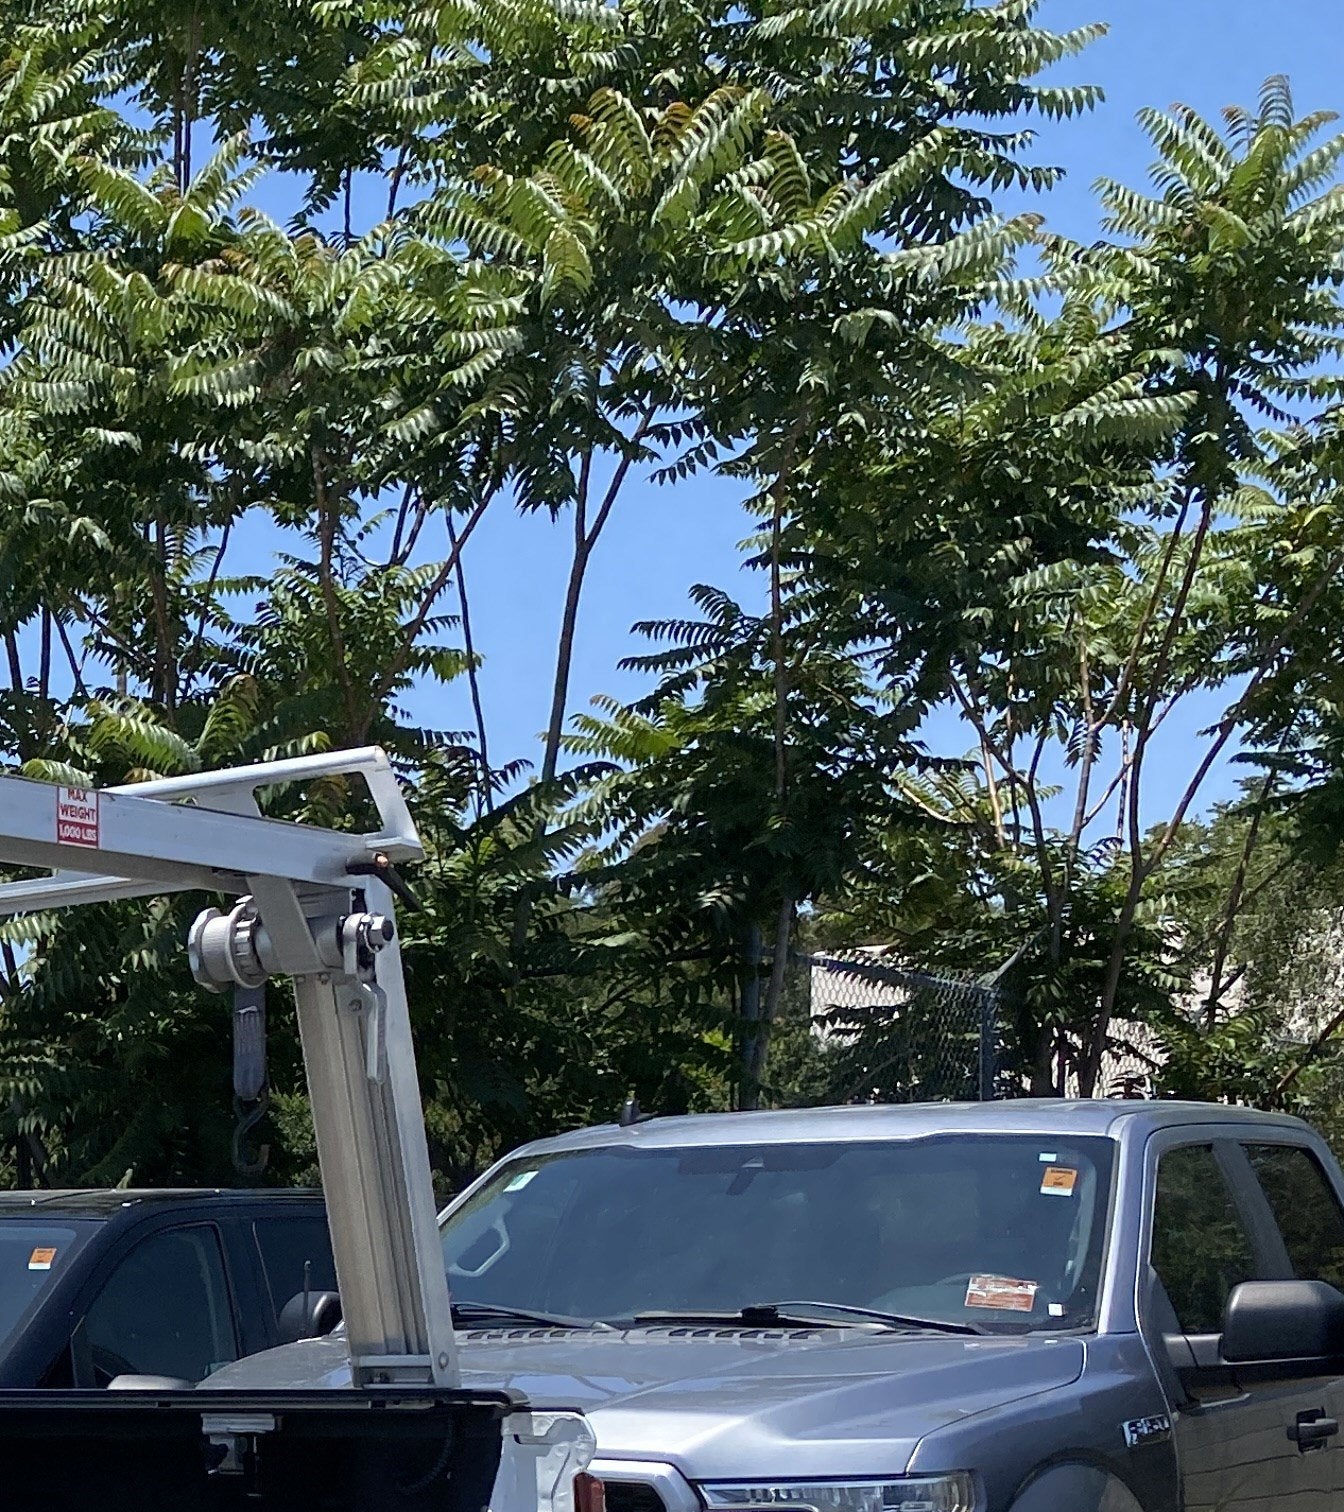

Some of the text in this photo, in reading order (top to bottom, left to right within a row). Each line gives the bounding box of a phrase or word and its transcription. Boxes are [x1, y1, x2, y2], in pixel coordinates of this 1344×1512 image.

[68, 788, 87, 802] MAX
[61, 804, 96, 821] WEIGHT
[59, 823, 97, 841] 1,000 LBS
